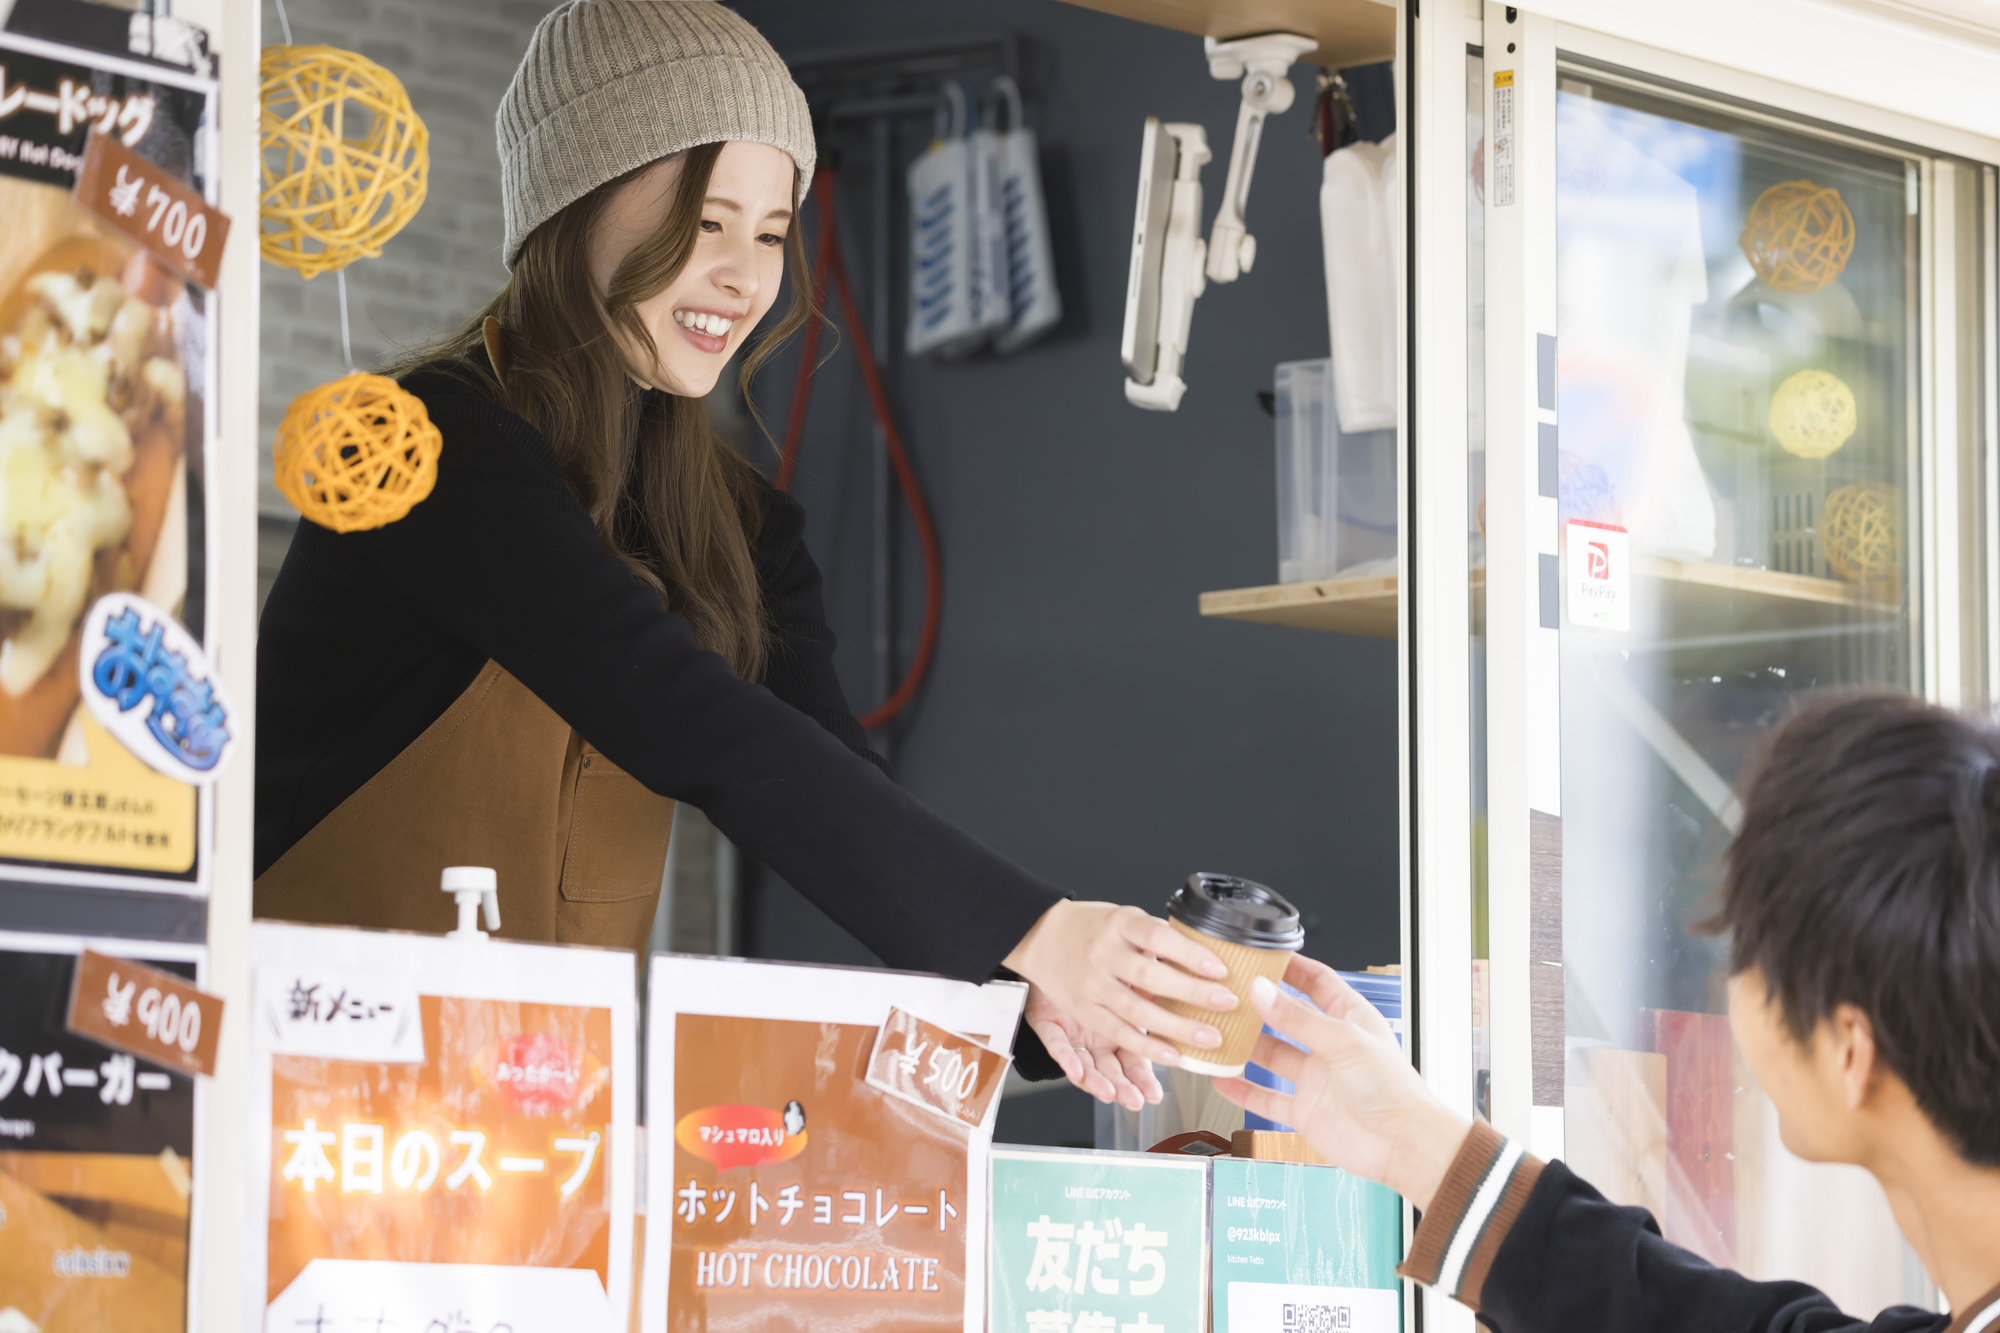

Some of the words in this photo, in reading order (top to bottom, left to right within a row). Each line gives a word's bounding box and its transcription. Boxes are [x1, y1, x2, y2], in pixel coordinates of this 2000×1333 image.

[109, 164, 207, 260] ¥700
[1581, 582, 1616, 603] PayPay
[102, 971, 201, 1053] ¥900
[287, 978, 394, 1022] 新メニュー
[899, 1033, 979, 1099] ¥500
[282, 1117, 600, 1199] 本日のスープ
[699, 1125, 785, 1147] マシュマロ入り
[677, 1179, 958, 1232] ホットチョコレート
[1065, 1186, 1084, 1199] LINE
[1085, 1188, 1131, 1201] 公式アカウント
[1227, 1196, 1245, 1208] LINE
[1246, 1198, 1288, 1210] 公式アカウント
[697, 1251, 758, 1288] HOT
[764, 1253, 940, 1291] CHOCOLATE
[1025, 1215, 1168, 1296] 友だち
[1227, 1254, 1249, 1264] kitchen
[1249, 1255, 1265, 1265] Tetto
